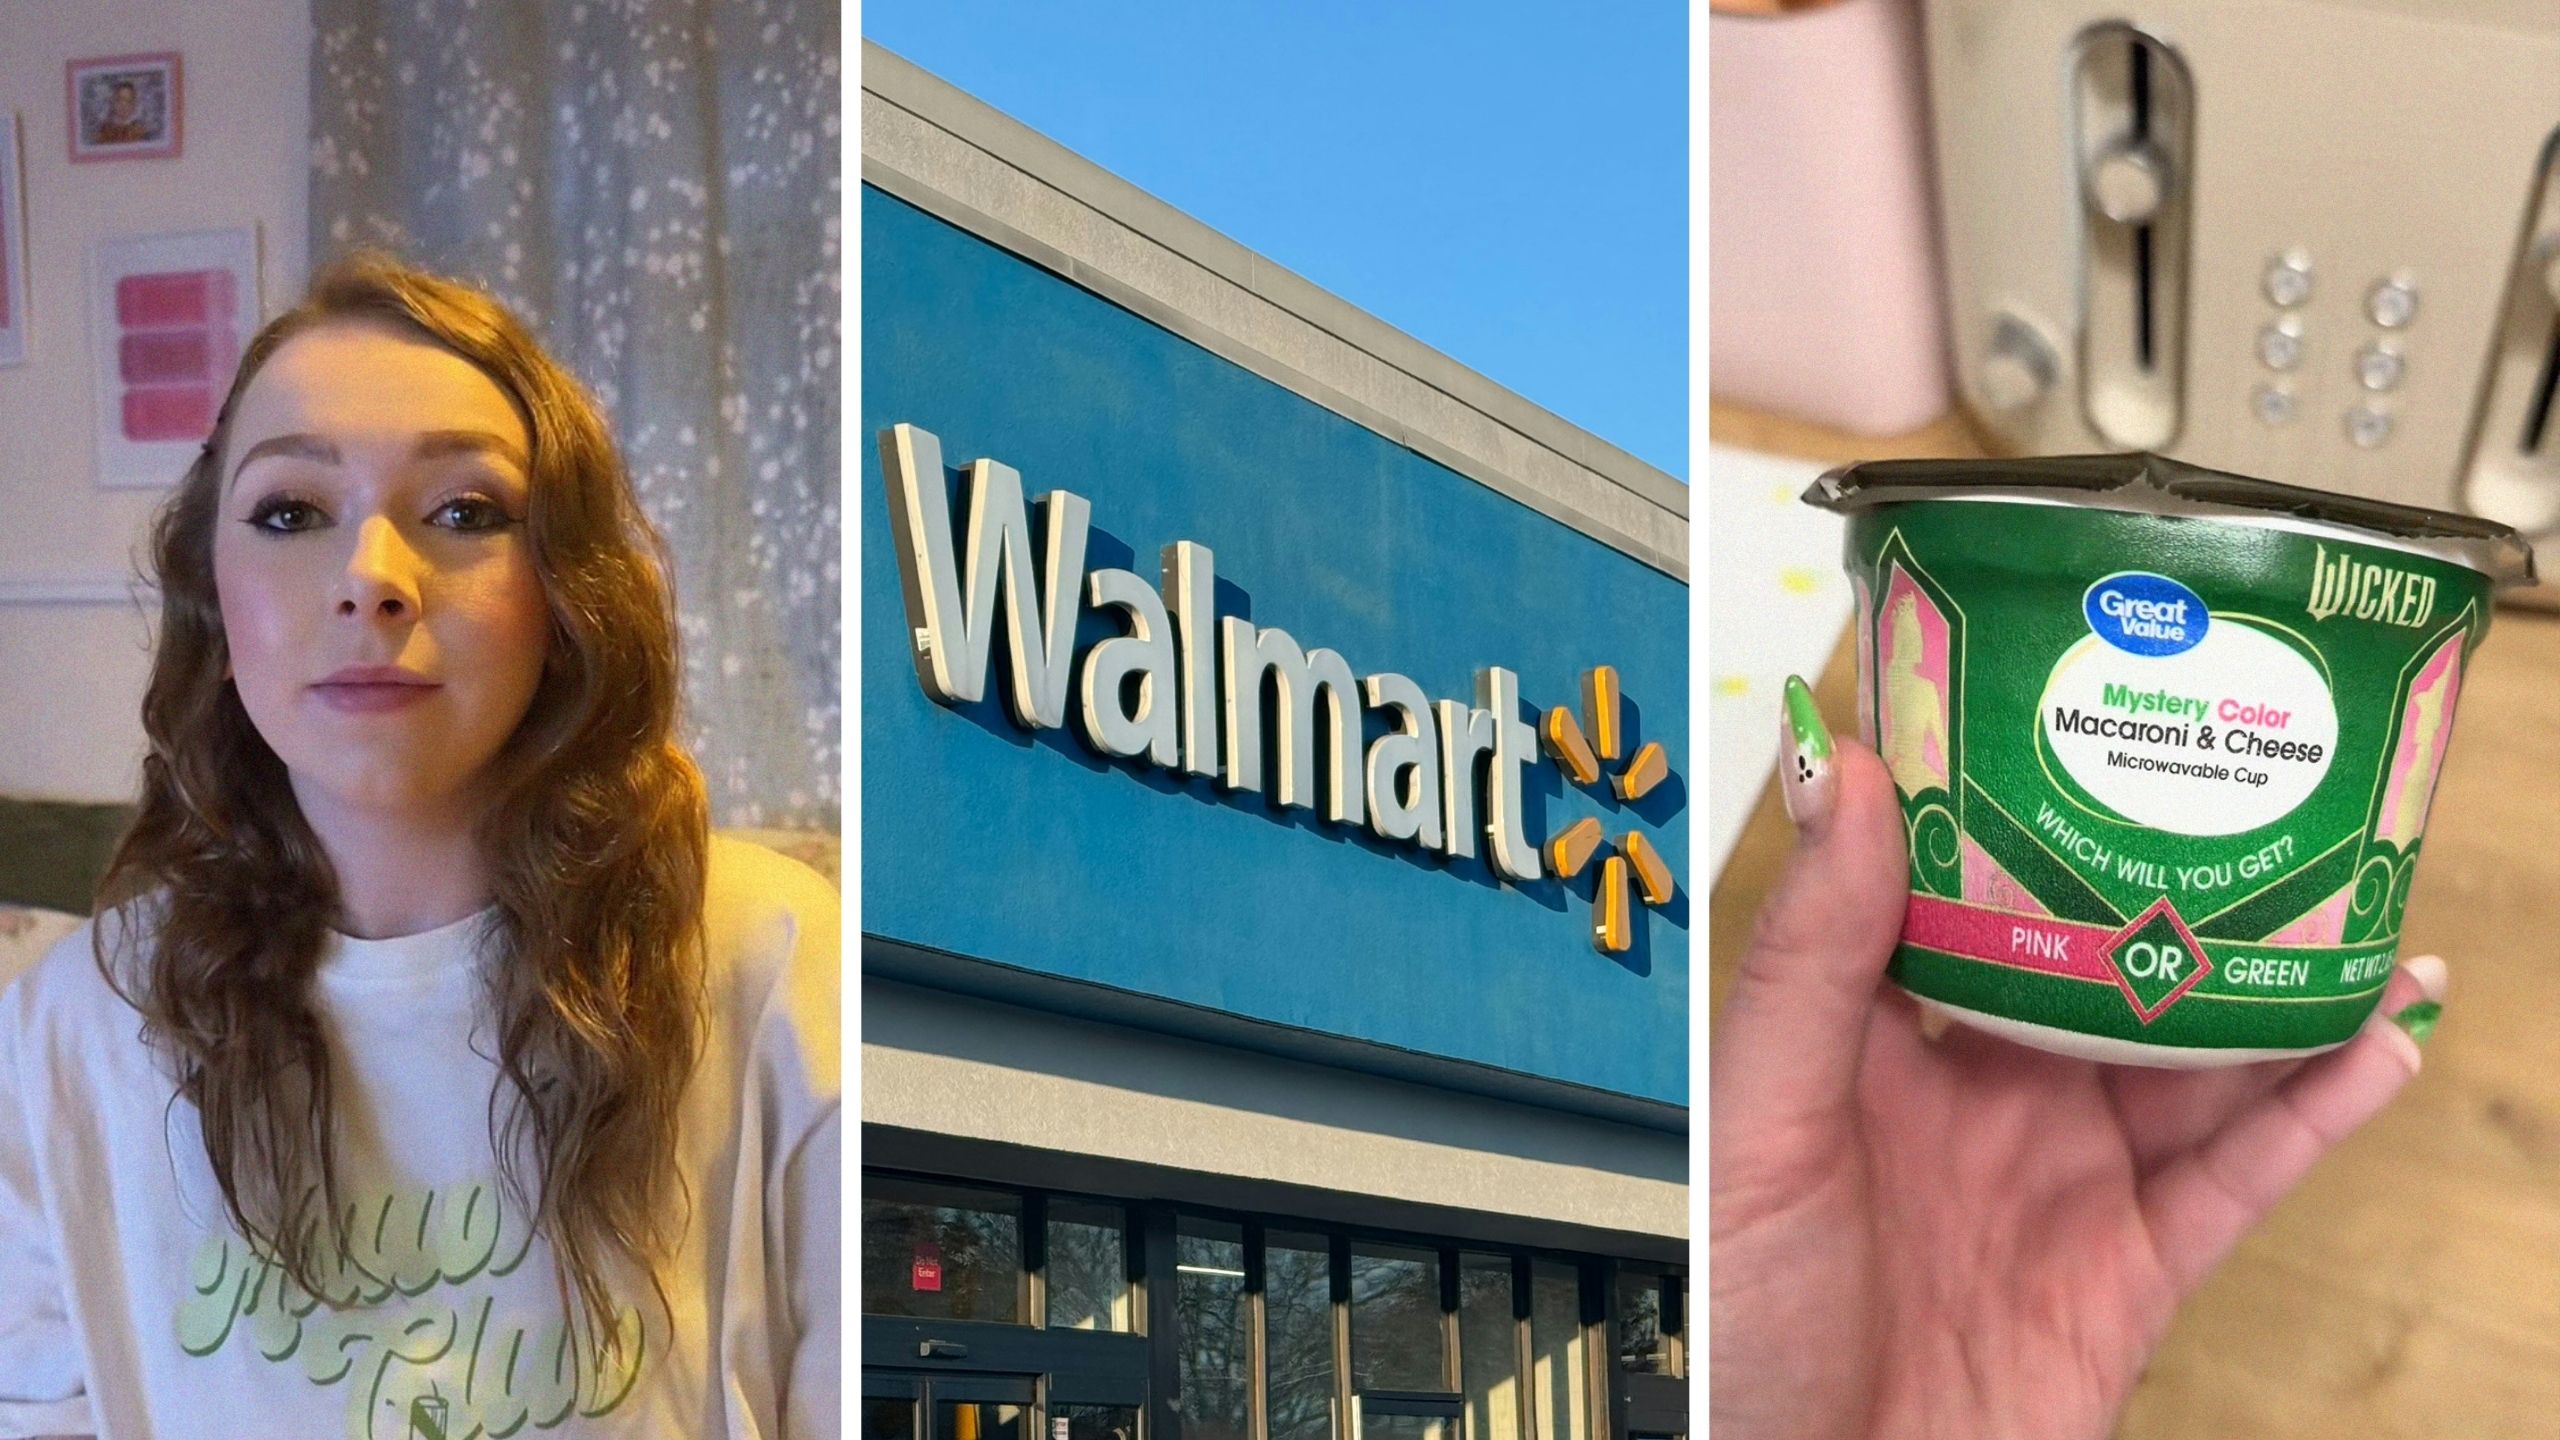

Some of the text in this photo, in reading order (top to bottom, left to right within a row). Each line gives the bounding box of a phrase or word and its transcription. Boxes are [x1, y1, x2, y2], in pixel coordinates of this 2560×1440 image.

[2099, 589, 2188, 624] Great
[2120, 617, 2185, 641] Value
[878, 422, 1541, 880] Walmart
[2102, 683, 2291, 729] Mystery Color
[2055, 707, 2323, 763] Macaroni & Cheese
[2107, 751, 2268, 787] Microwavable Cup
[2035, 800, 2294, 890] WHICH WILL YOU GET?
[2011, 927, 2310, 986] PINK OR GREEN
[2340, 957, 2365, 984] NET
